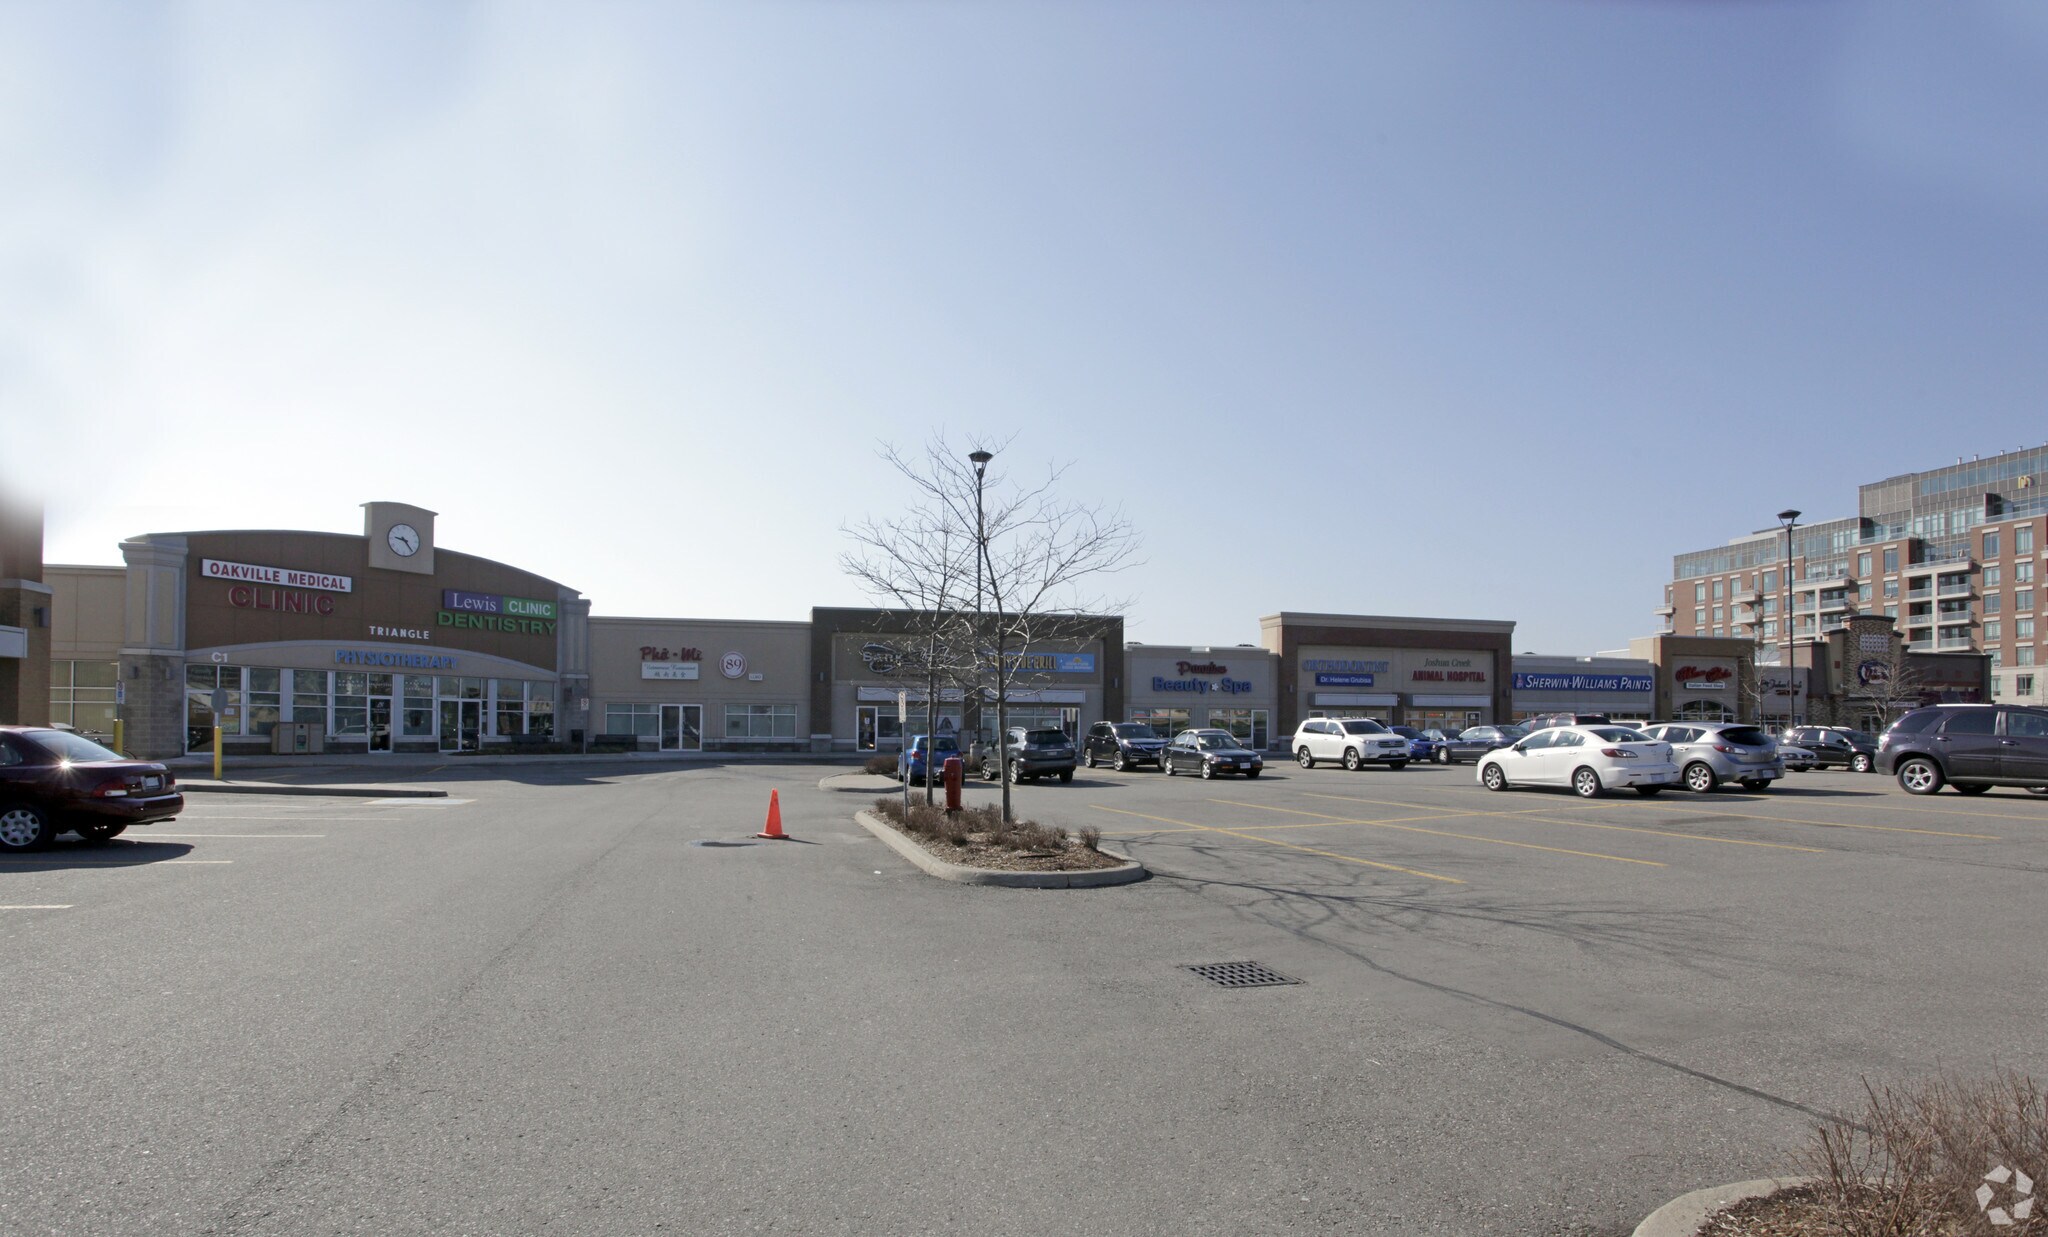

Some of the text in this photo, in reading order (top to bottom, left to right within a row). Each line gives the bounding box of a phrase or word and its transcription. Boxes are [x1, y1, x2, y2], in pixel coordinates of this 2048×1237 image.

[210, 562, 346, 590] OAKVILLE MEDICAL
[228, 585, 335, 616] CLINIC
[453, 592, 551, 616] Lewis CLINIC
[437, 611, 557, 635] DENTISTRY
[369, 625, 430, 640] TRIANGLE
[211, 651, 228, 663] C1
[335, 649, 459, 669] PHYSIOTHERAPY
[725, 658, 742, 670] 89
[1152, 676, 1252, 694] Beauty Spa
[1411, 670, 1486, 683] ANIMAL HOSPITAL
[1525, 675, 1652, 690] SHERWIN-WILLIAMS PAINTS
